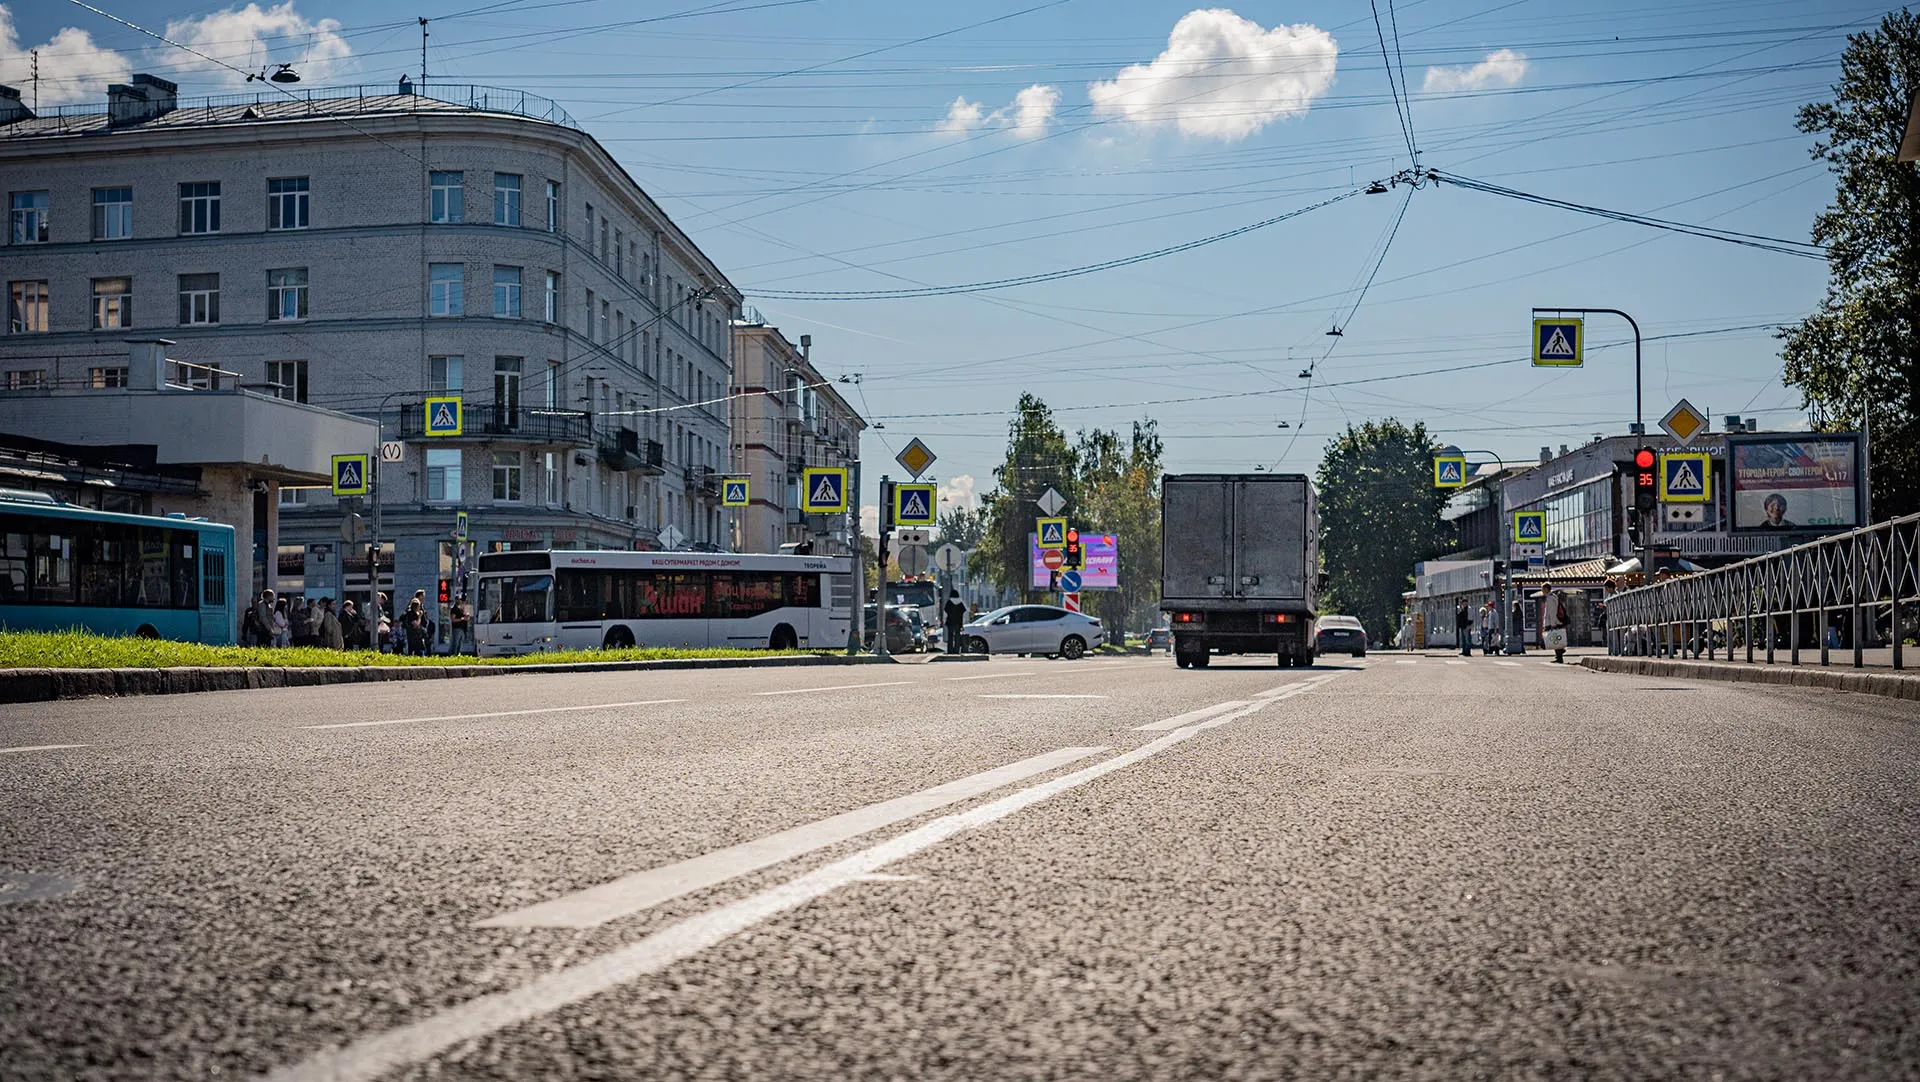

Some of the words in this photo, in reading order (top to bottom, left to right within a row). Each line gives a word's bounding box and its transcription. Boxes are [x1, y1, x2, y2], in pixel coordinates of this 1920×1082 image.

[1639, 473, 1653, 486] 35
[1068, 544, 1077, 552] 35
[440, 593, 449, 602] 05
